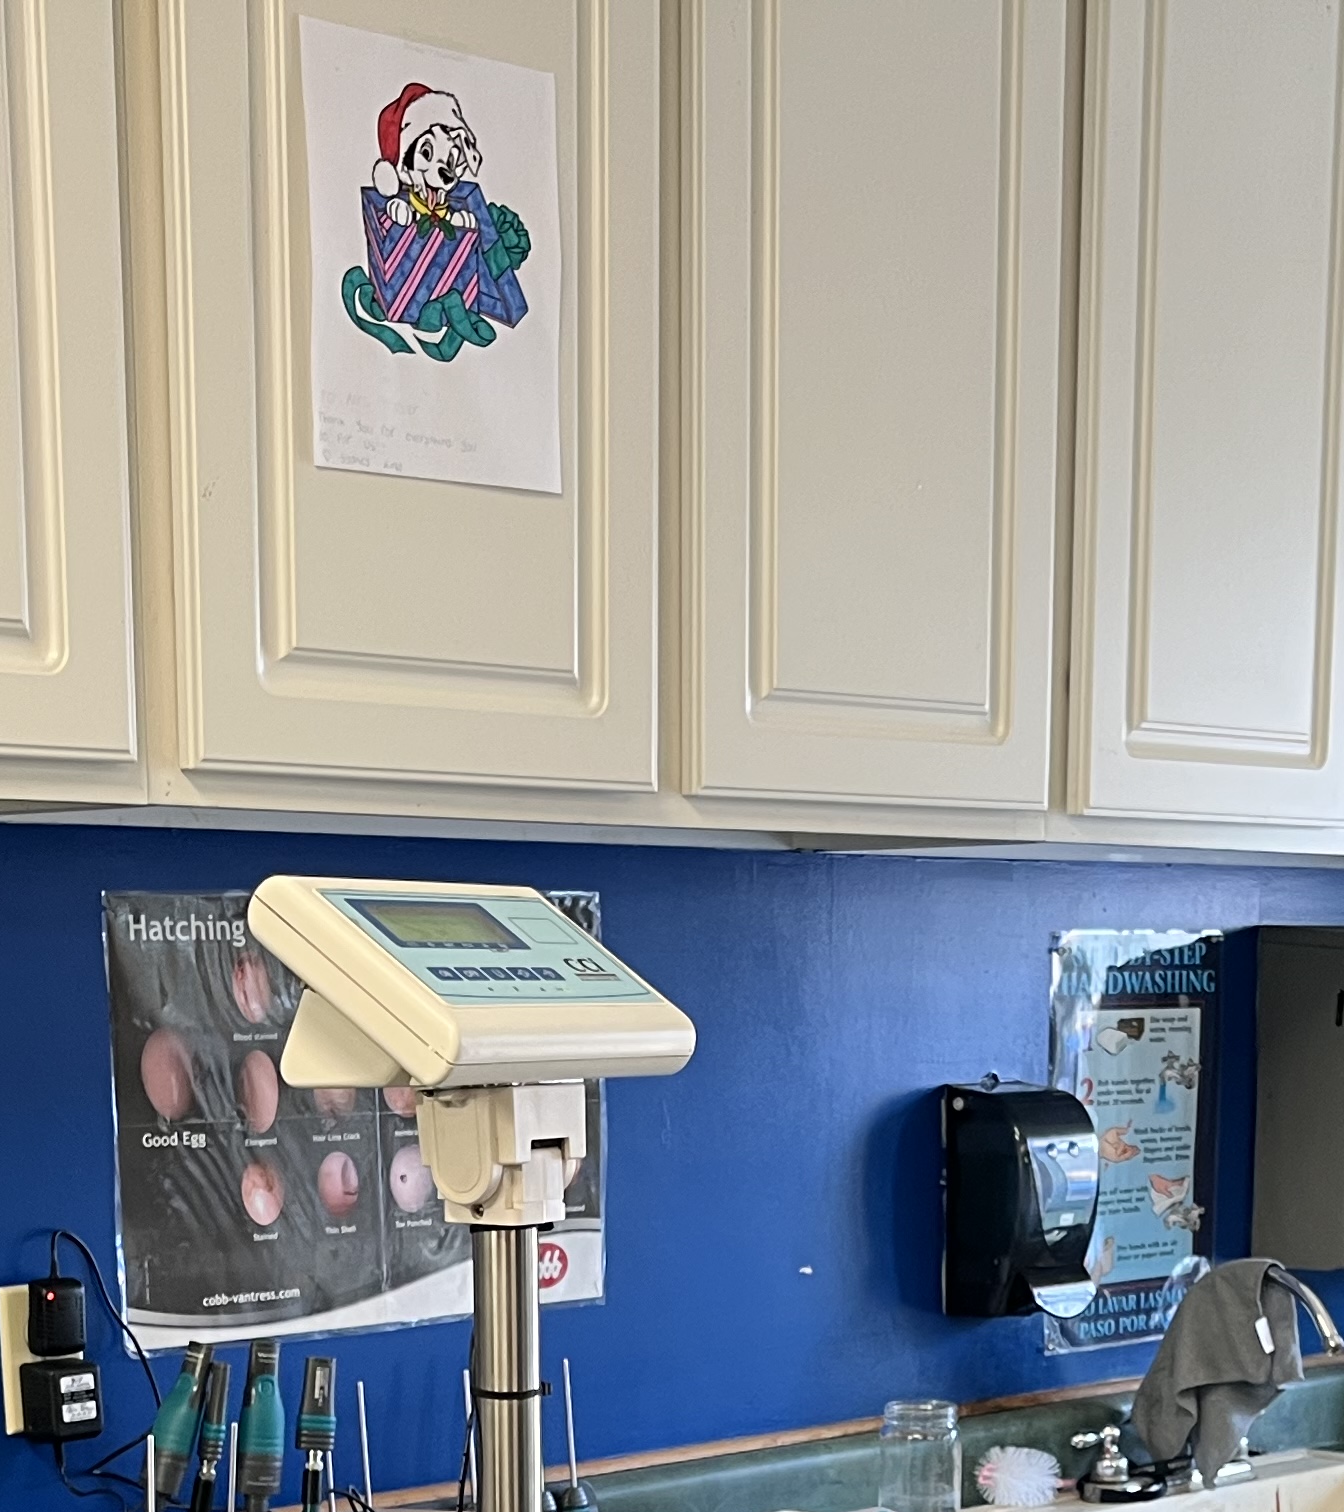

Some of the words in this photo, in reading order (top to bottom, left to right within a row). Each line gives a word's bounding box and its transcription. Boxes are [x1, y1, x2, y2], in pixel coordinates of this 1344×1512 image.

[127, 913, 247, 947] Hatching
[1080, 1077, 1095, 1106] 2
[142, 1131, 179, 1148] Good
[182, 1130, 207, 1149] Egg
[202, 1287, 301, 1308] cobb-vantress.com
[1079, 1318, 1116, 1340] PASO
[1119, 1314, 1147, 1334] POR
